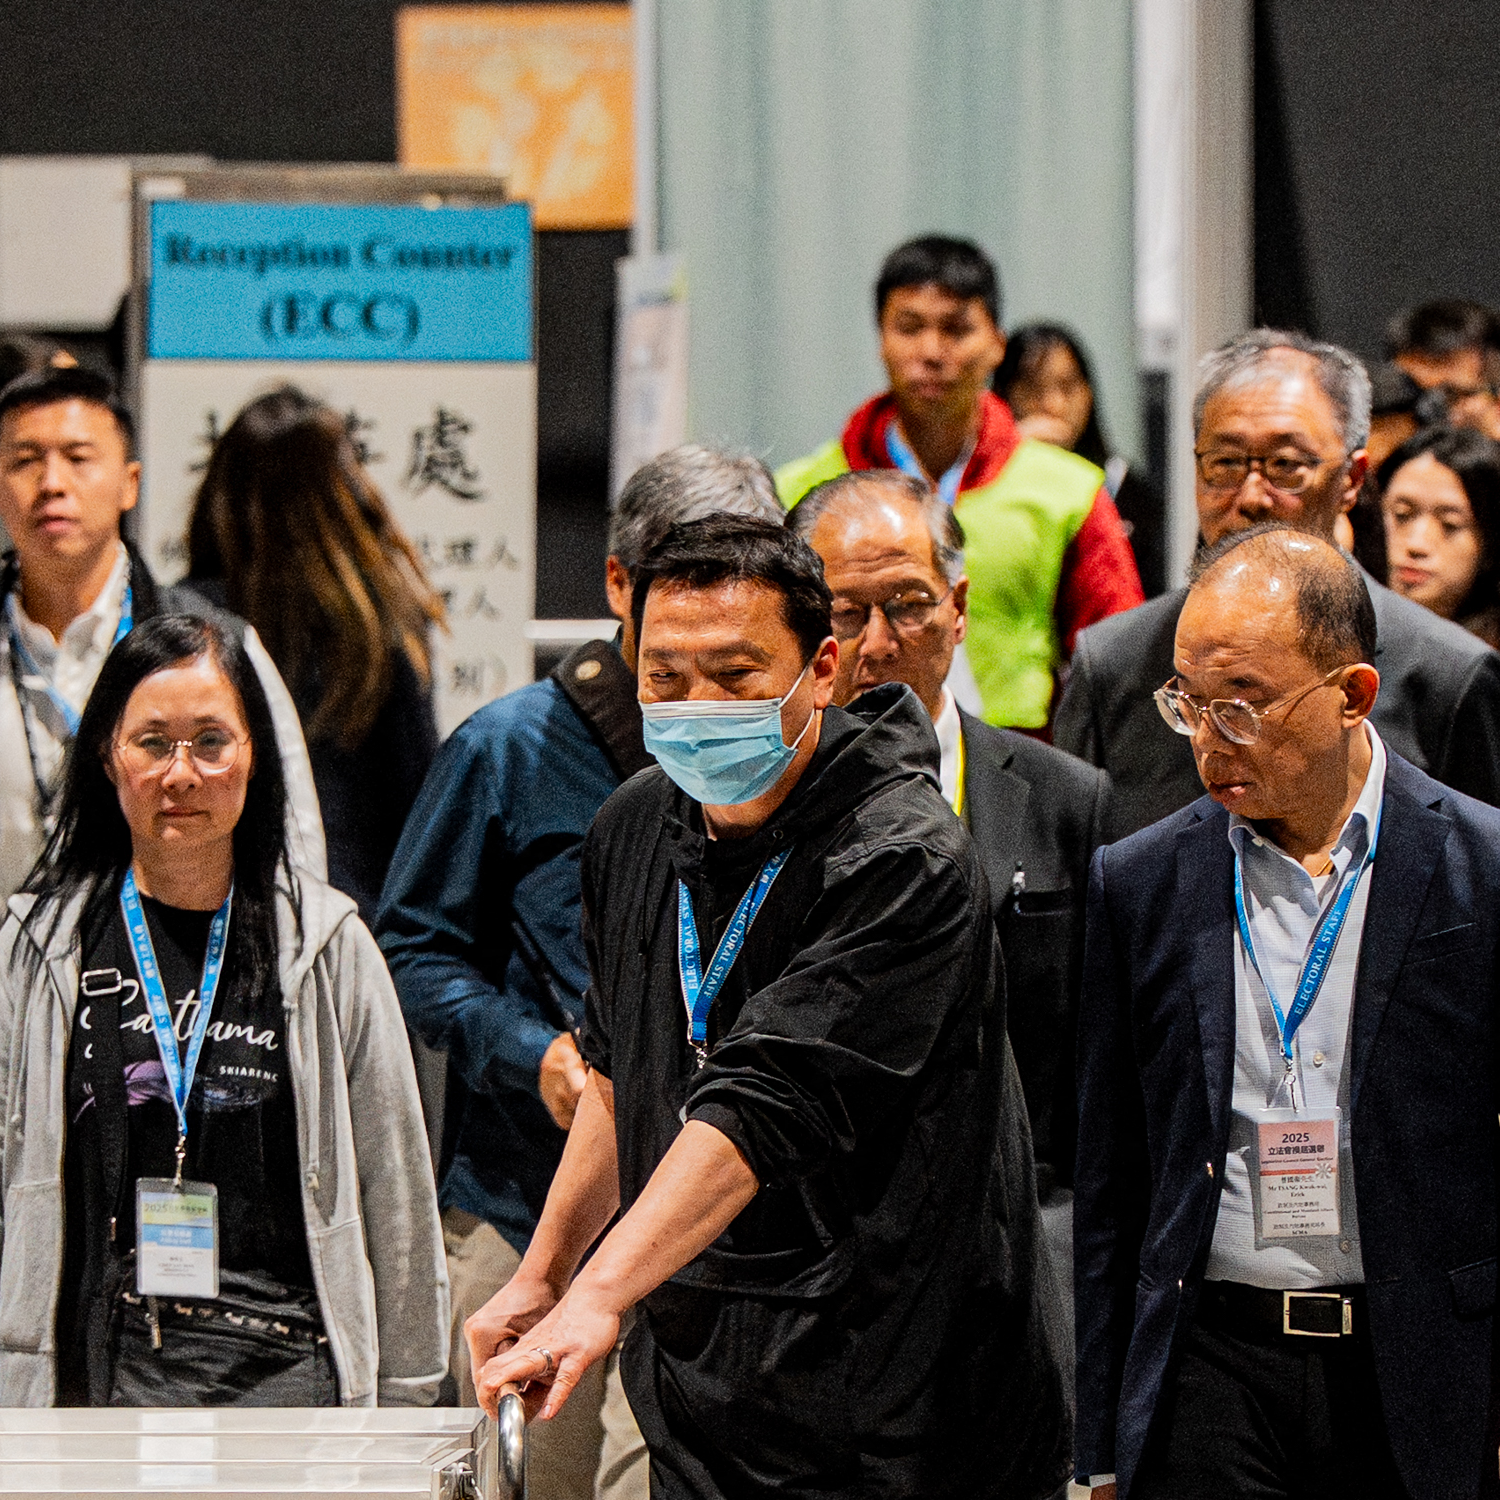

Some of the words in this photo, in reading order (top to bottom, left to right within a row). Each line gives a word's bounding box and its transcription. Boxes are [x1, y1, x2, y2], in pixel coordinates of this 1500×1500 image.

[165, 233, 350, 278] Reception
[362, 233, 517, 272] Counter
[259, 290, 420, 346] (ECC)
[683, 925, 699, 990] ELECTORAL
[703, 963, 725, 999] STAFF
[1293, 945, 1329, 1016] ELECTORAL
[1321, 908, 1342, 944] STAFF
[1281, 1132, 1310, 1143] 2025
